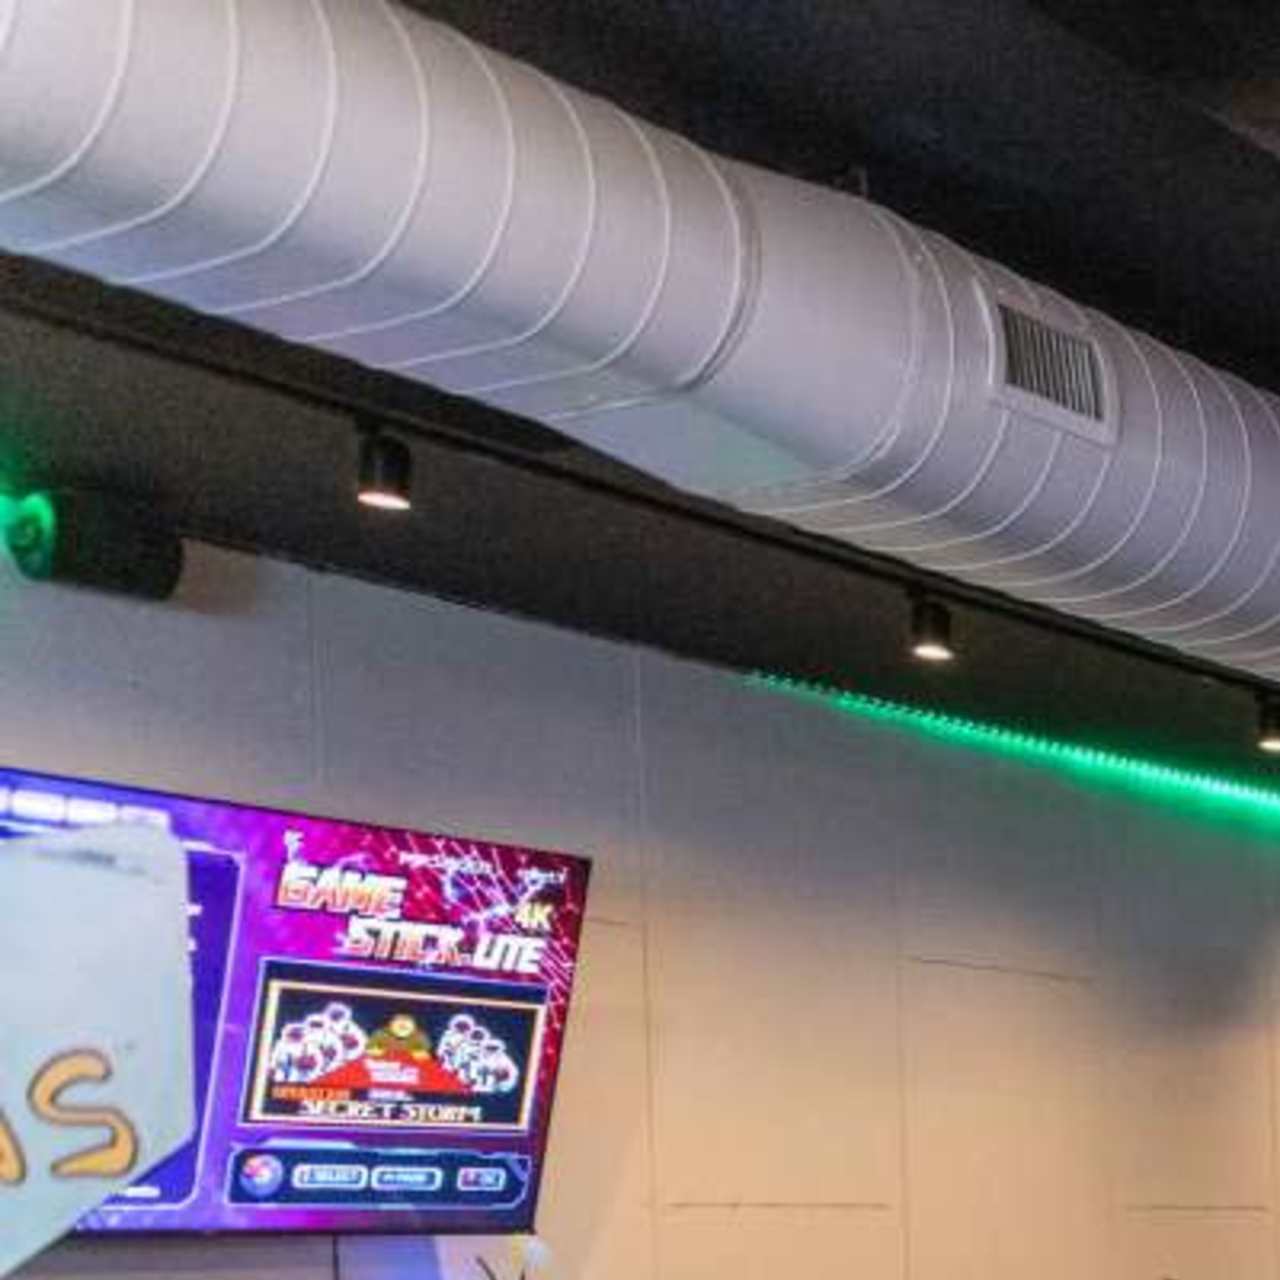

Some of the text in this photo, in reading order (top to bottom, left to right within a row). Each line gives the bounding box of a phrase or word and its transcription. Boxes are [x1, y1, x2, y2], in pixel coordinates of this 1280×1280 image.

[277, 862, 407, 919] GAME
[514, 903, 555, 931] 4K
[345, 916, 548, 973] STICK LITE
[0, 1047, 139, 1187] S
